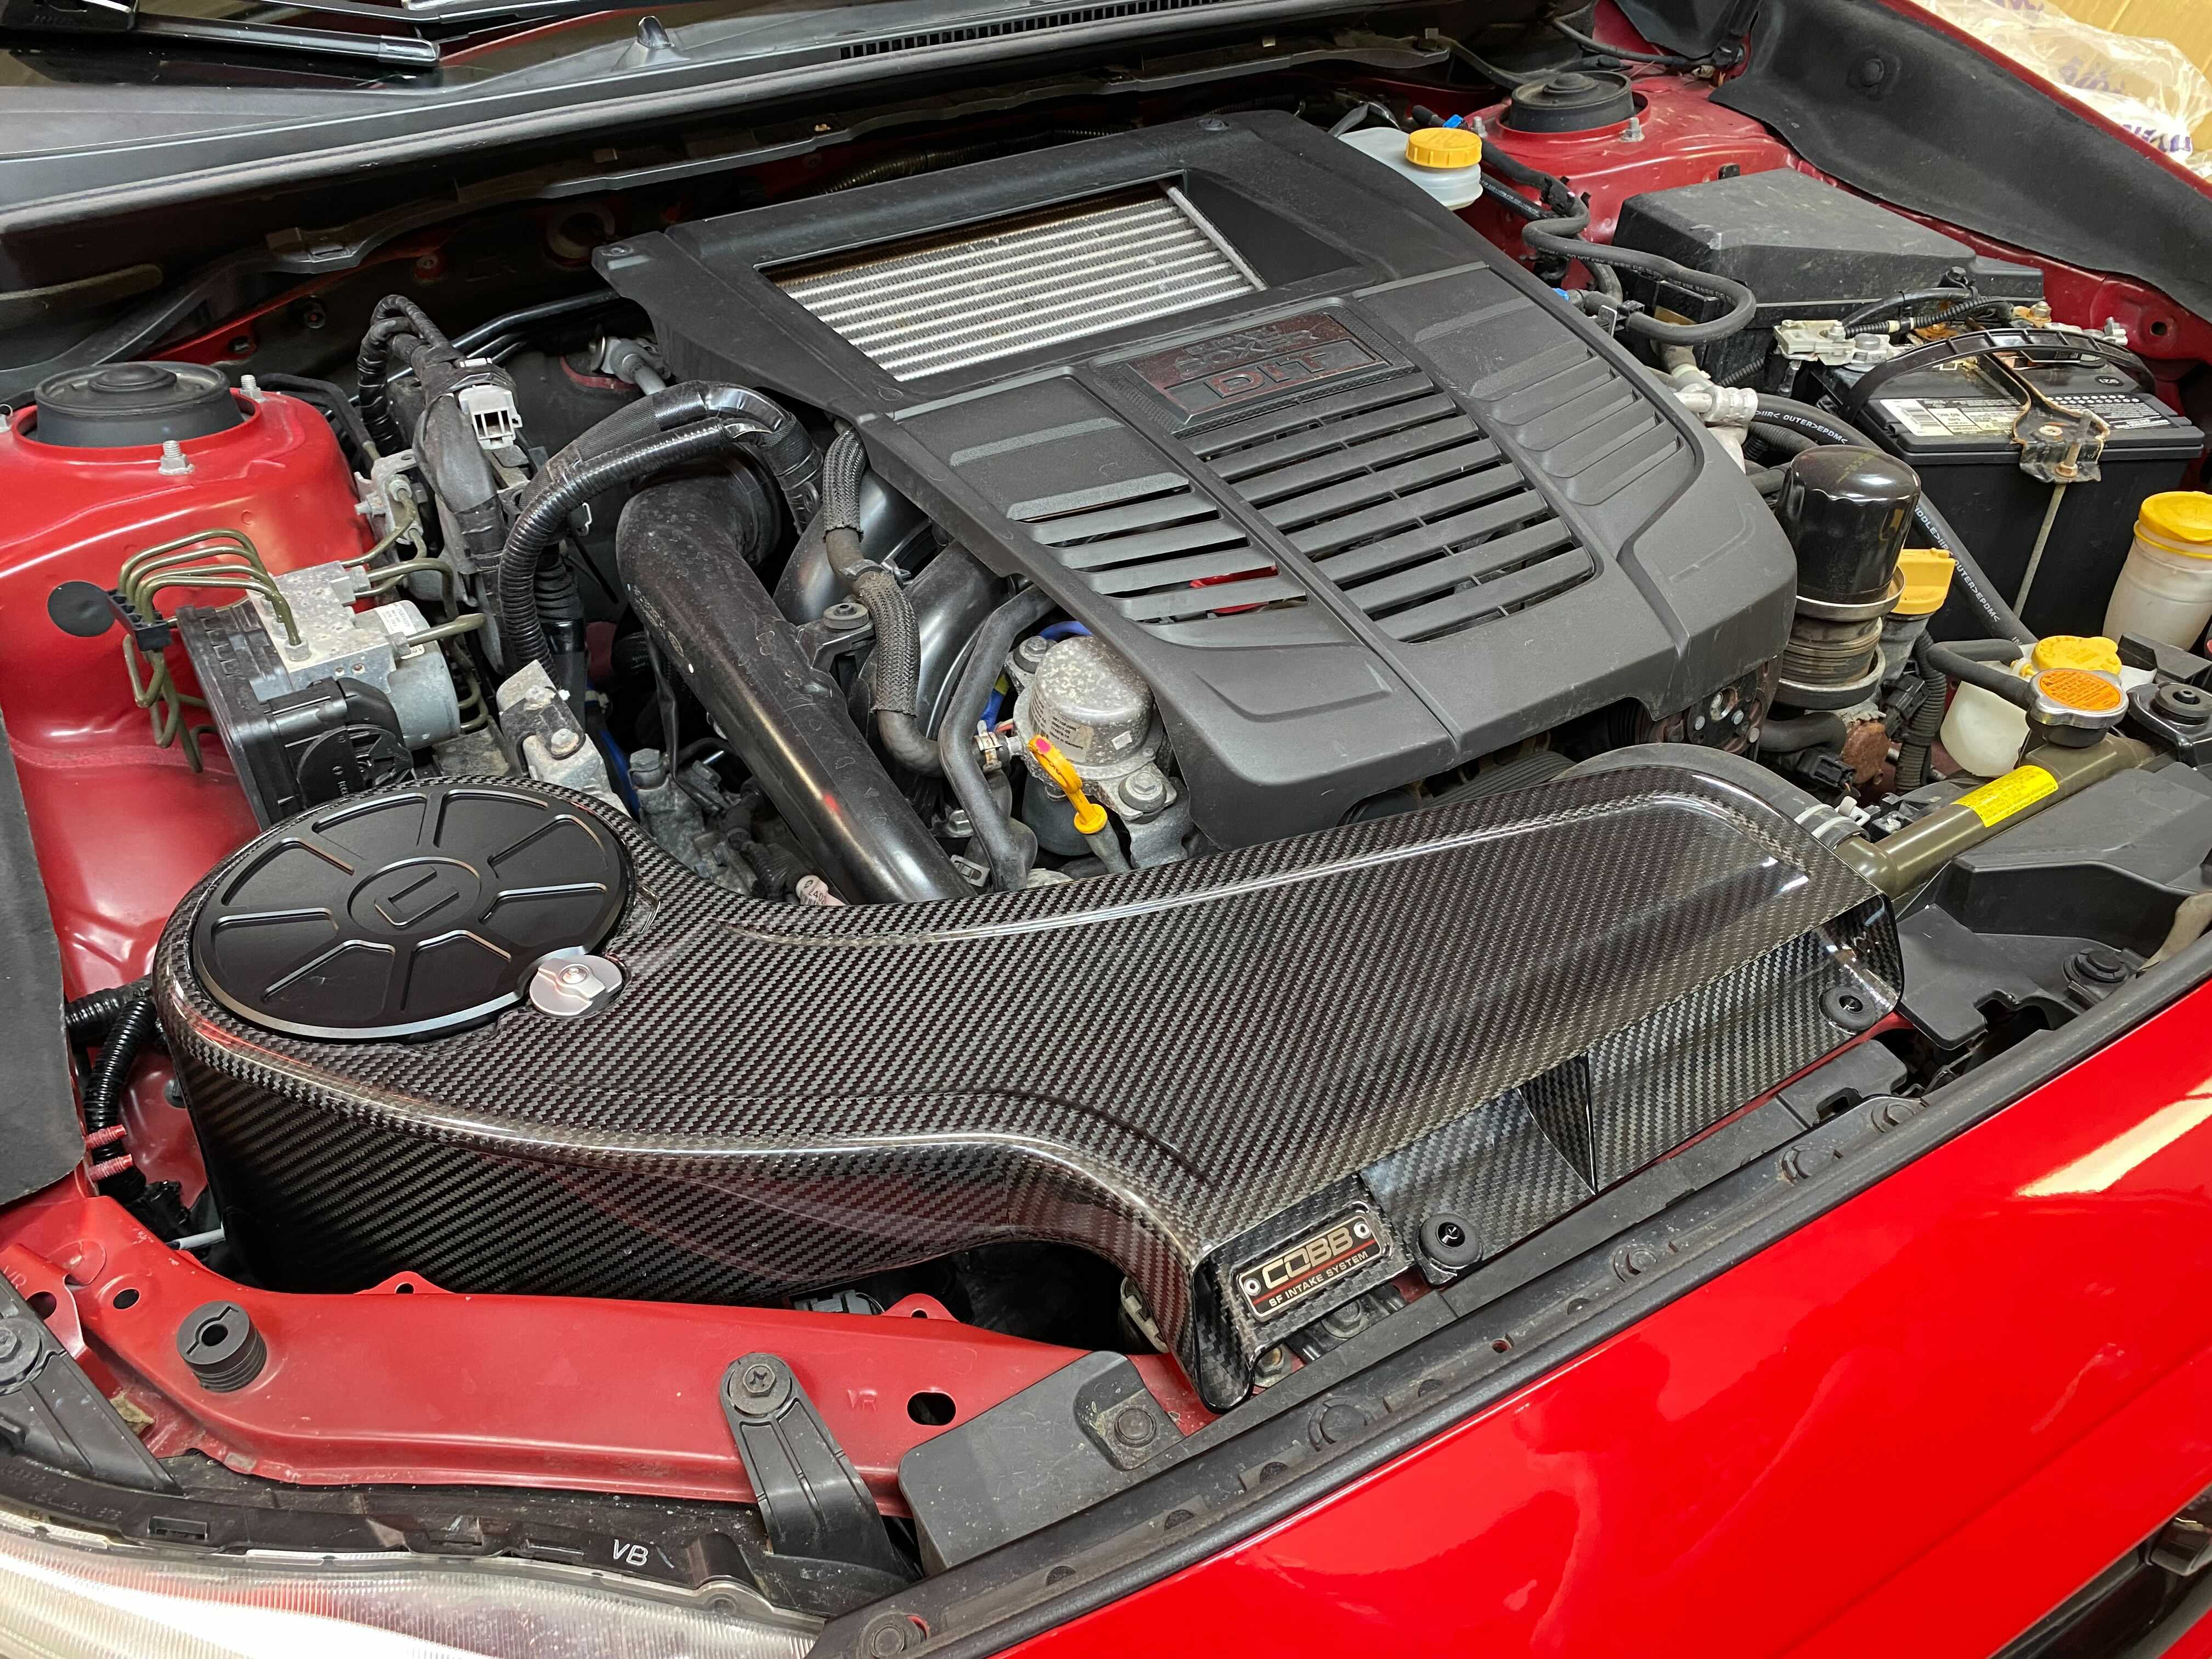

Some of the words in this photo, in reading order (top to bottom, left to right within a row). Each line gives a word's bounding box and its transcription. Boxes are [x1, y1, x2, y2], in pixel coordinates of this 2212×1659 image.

[1203, 352, 1326, 398] DIT
[1262, 1227, 1354, 1290] COBB
[1268, 1293, 1283, 1308] SF
[1285, 1273, 1324, 1300] INTAKE
[1325, 1250, 1369, 1278] SYSTEM
[847, 1389, 878, 1414] VR
[611, 1538, 649, 1567] VB
